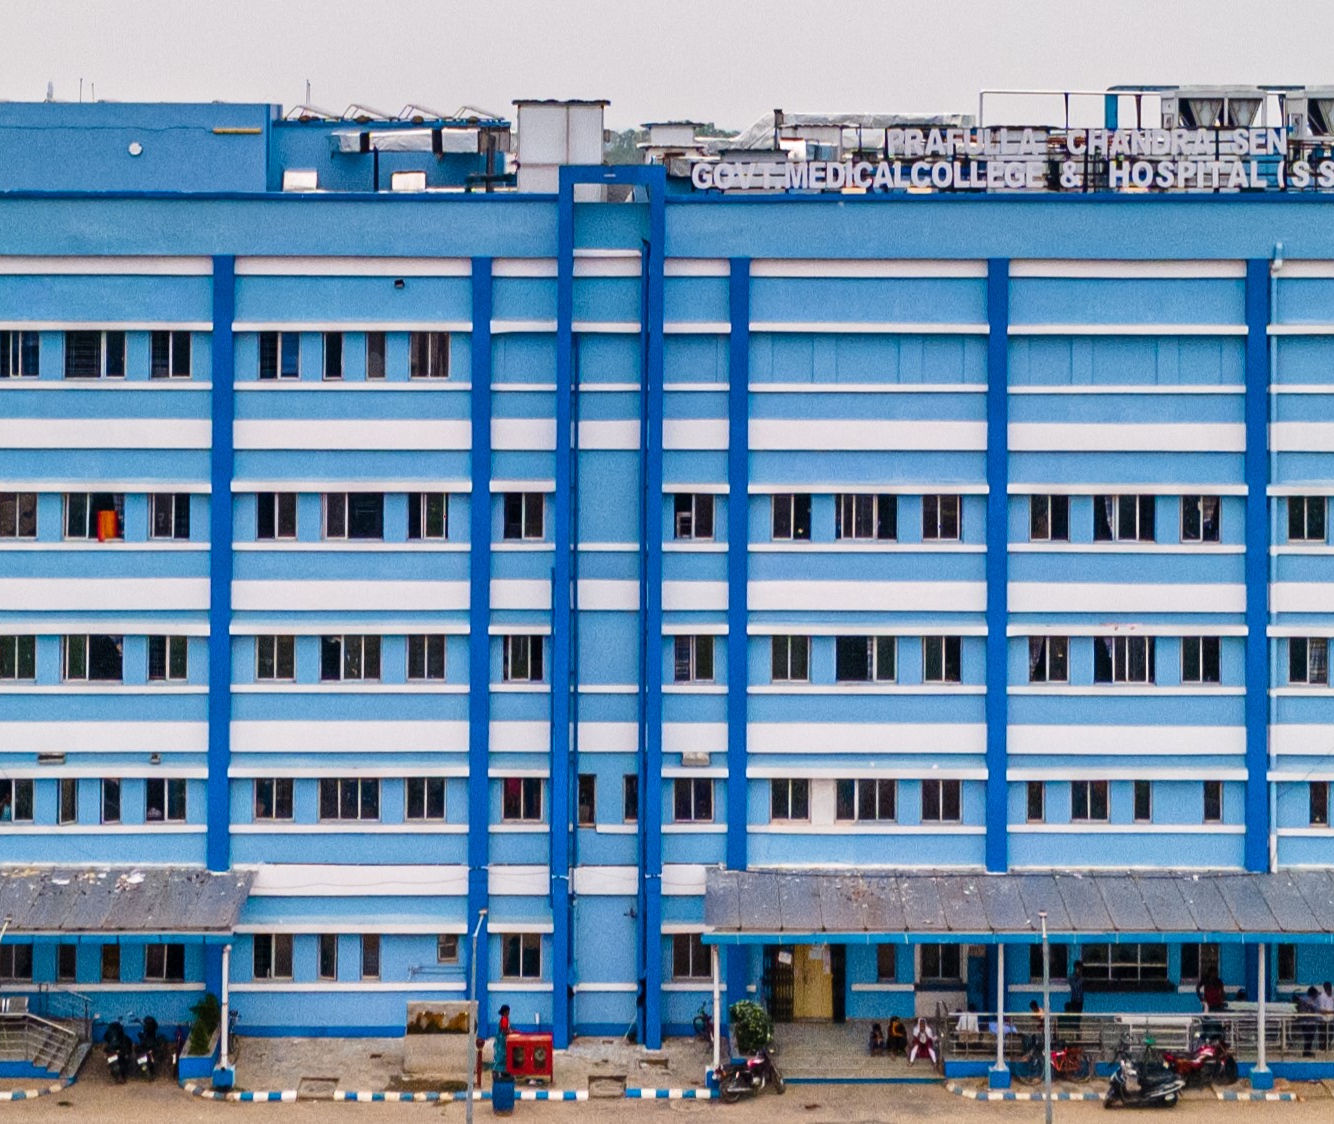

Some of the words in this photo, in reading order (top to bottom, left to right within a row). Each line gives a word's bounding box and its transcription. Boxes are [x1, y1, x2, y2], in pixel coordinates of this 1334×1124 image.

[887, 128, 1039, 157] PRAFULLA
[1067, 128, 1214, 156] CHANDRA
[1232, 127, 1287, 155] SEN
[1059, 160, 1082, 189] &
[1108, 160, 1267, 189] HOSPITAL
